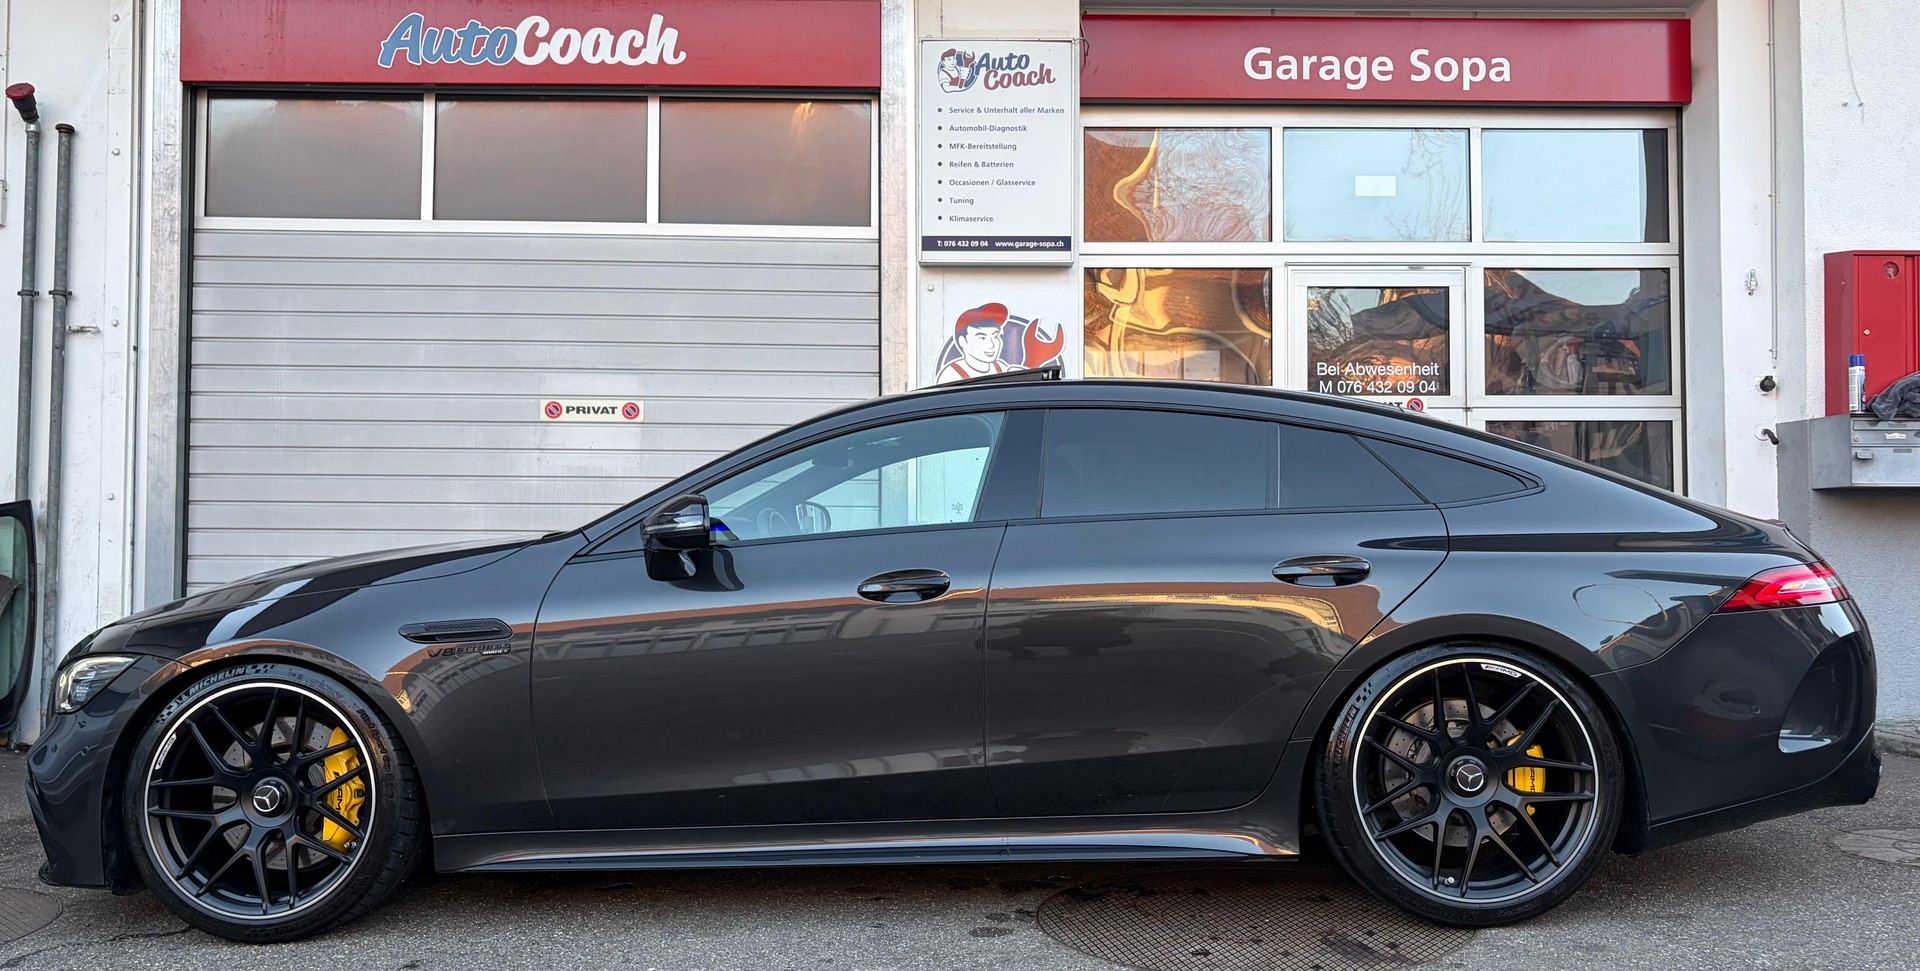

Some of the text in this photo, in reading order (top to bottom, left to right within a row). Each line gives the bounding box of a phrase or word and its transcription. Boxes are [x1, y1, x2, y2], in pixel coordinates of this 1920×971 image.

[378, 12, 686, 68] AutoCoach
[975, 52, 1030, 76] Auto
[1244, 47, 1511, 91] Garage Sopa
[984, 63, 1056, 91] Coach
[949, 106, 1065, 114] Service & Unterhalt aller Marken
[949, 124, 1027, 133] Automobil-Diagnostik
[949, 142, 1017, 151] MFK-Bereitstellung
[949, 160, 1014, 168] Reifen & Batterien
[949, 178, 990, 187] Occasionen
[996, 178, 1036, 187] Glasservice
[949, 197, 974, 205] Tuning
[949, 214, 994, 222] Klimaservice
[995, 239, 1064, 248] www.garage-sopa.ch
[1316, 362, 1439, 376] Bei Abwesenheit
[1319, 380, 1437, 394] M 076 432 09 04
[565, 405, 618, 415] PRIVAT
[188, 665, 247, 697] MICHELIN
[1331, 703, 1360, 764] MICHELIN
